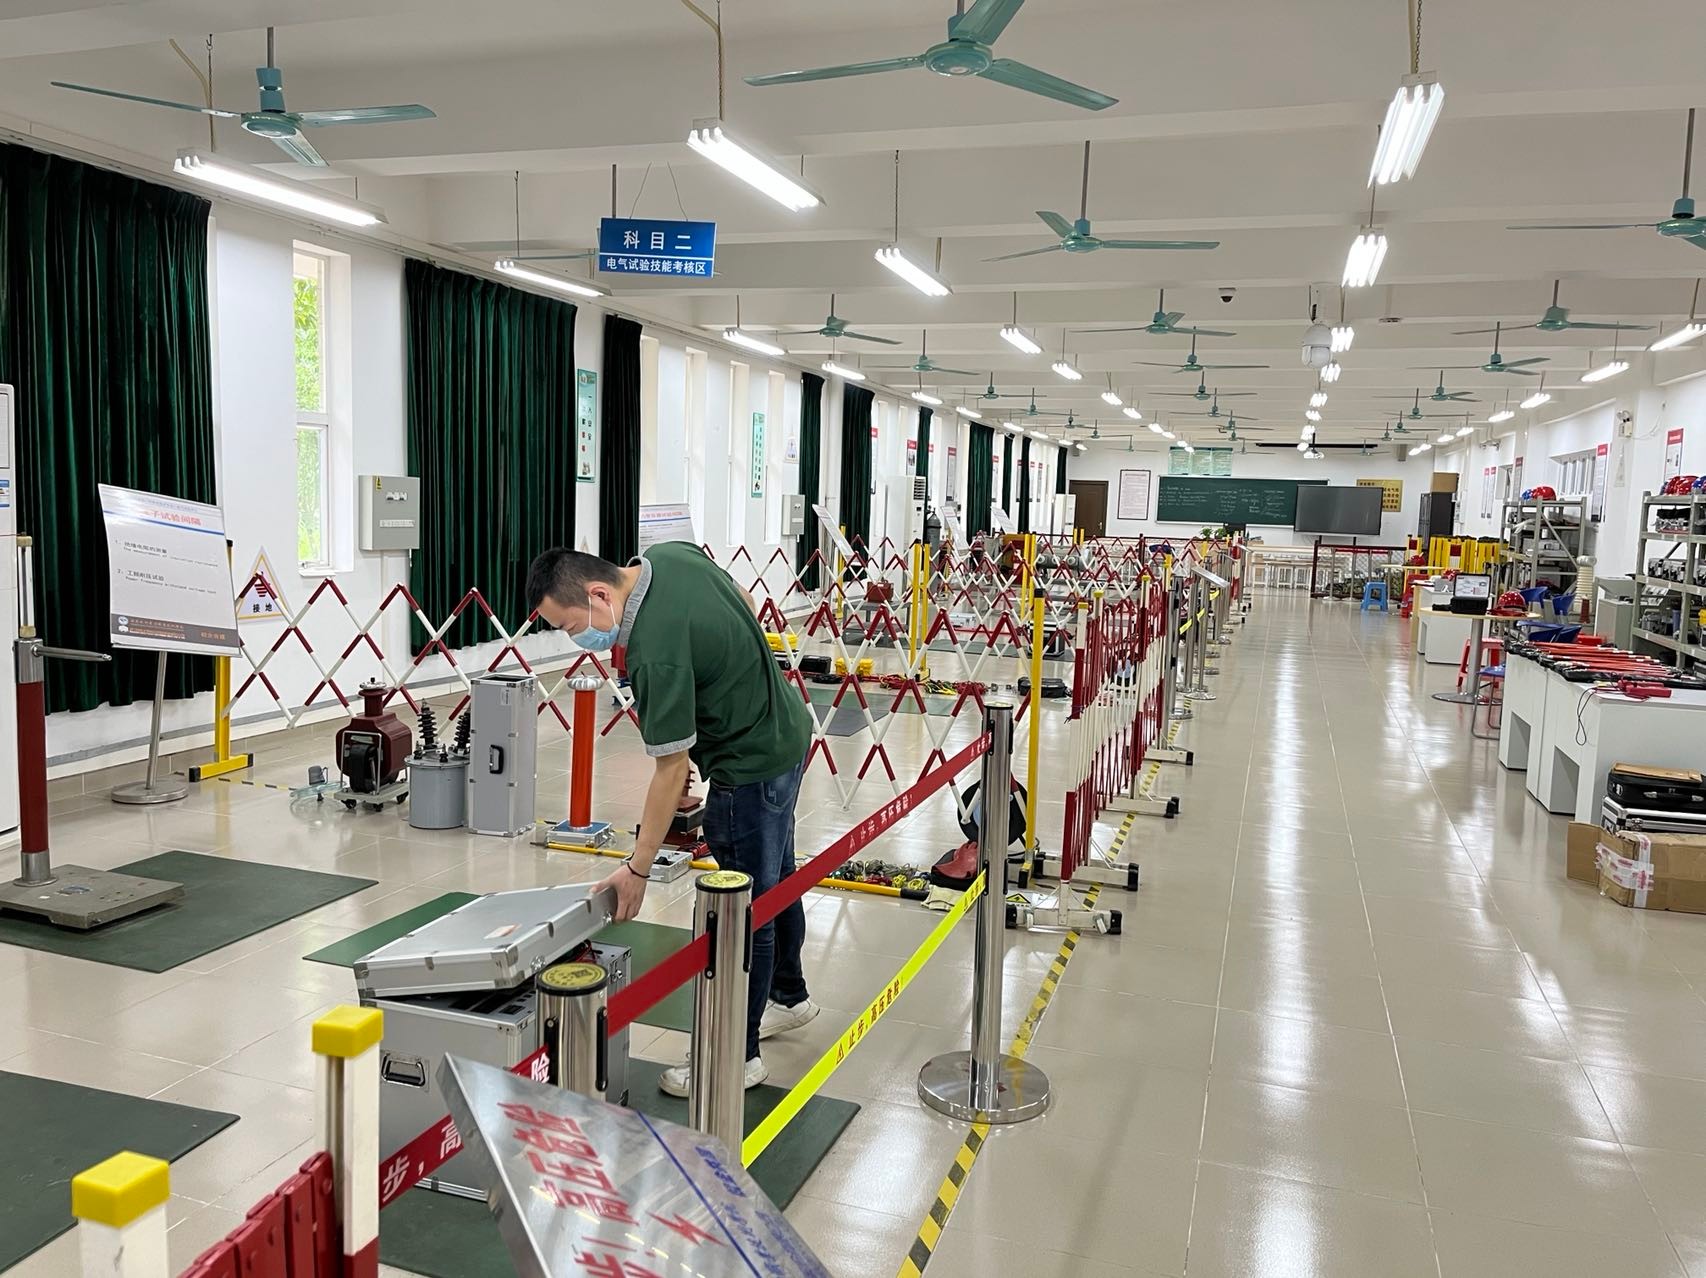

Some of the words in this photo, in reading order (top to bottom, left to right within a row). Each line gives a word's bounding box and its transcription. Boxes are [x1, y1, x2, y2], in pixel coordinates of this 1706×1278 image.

[624, 230, 692, 250] 科目二
[606, 257, 706, 275] 电气试验技能考核区
[252, 603, 273, 613] 接地
